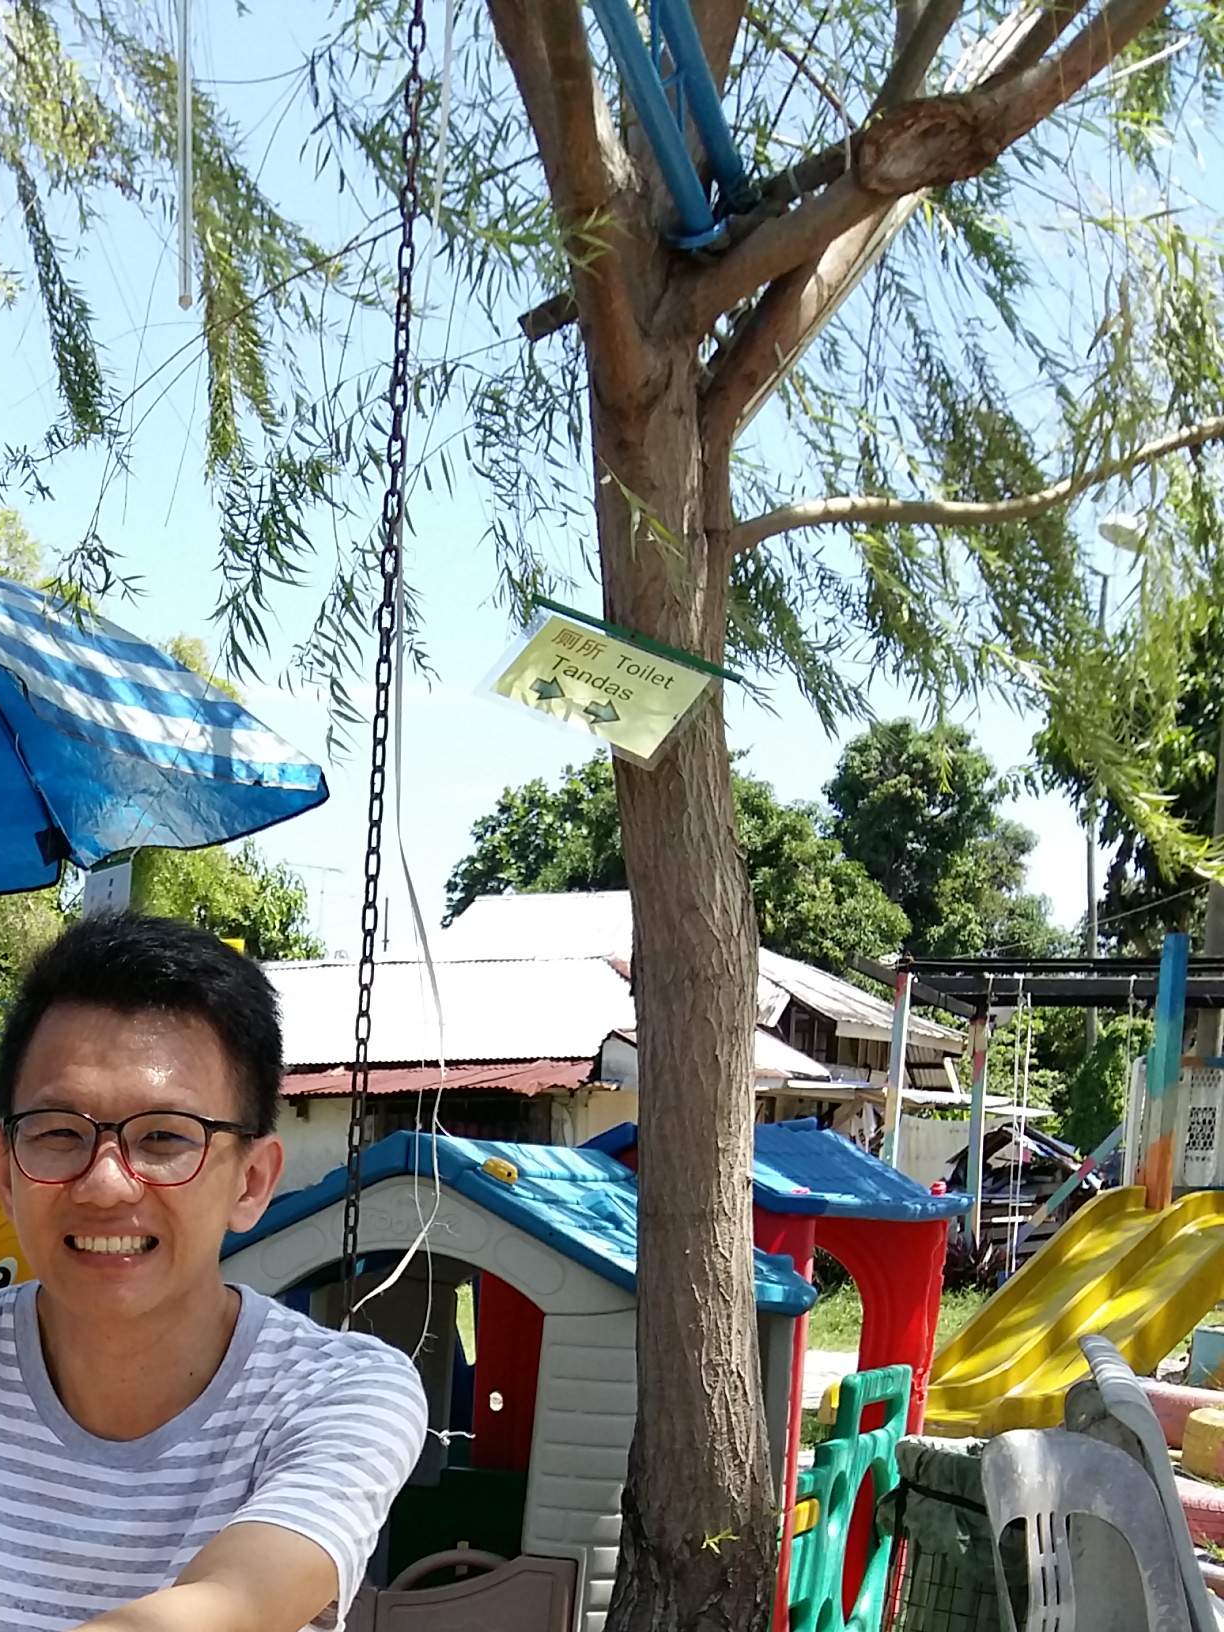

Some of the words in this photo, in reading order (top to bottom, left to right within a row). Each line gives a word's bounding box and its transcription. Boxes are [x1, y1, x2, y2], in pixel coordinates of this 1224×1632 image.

[551, 628, 608, 660] 厕所
[615, 655, 675, 689] Toilet
[551, 654, 634, 701] Tandas
